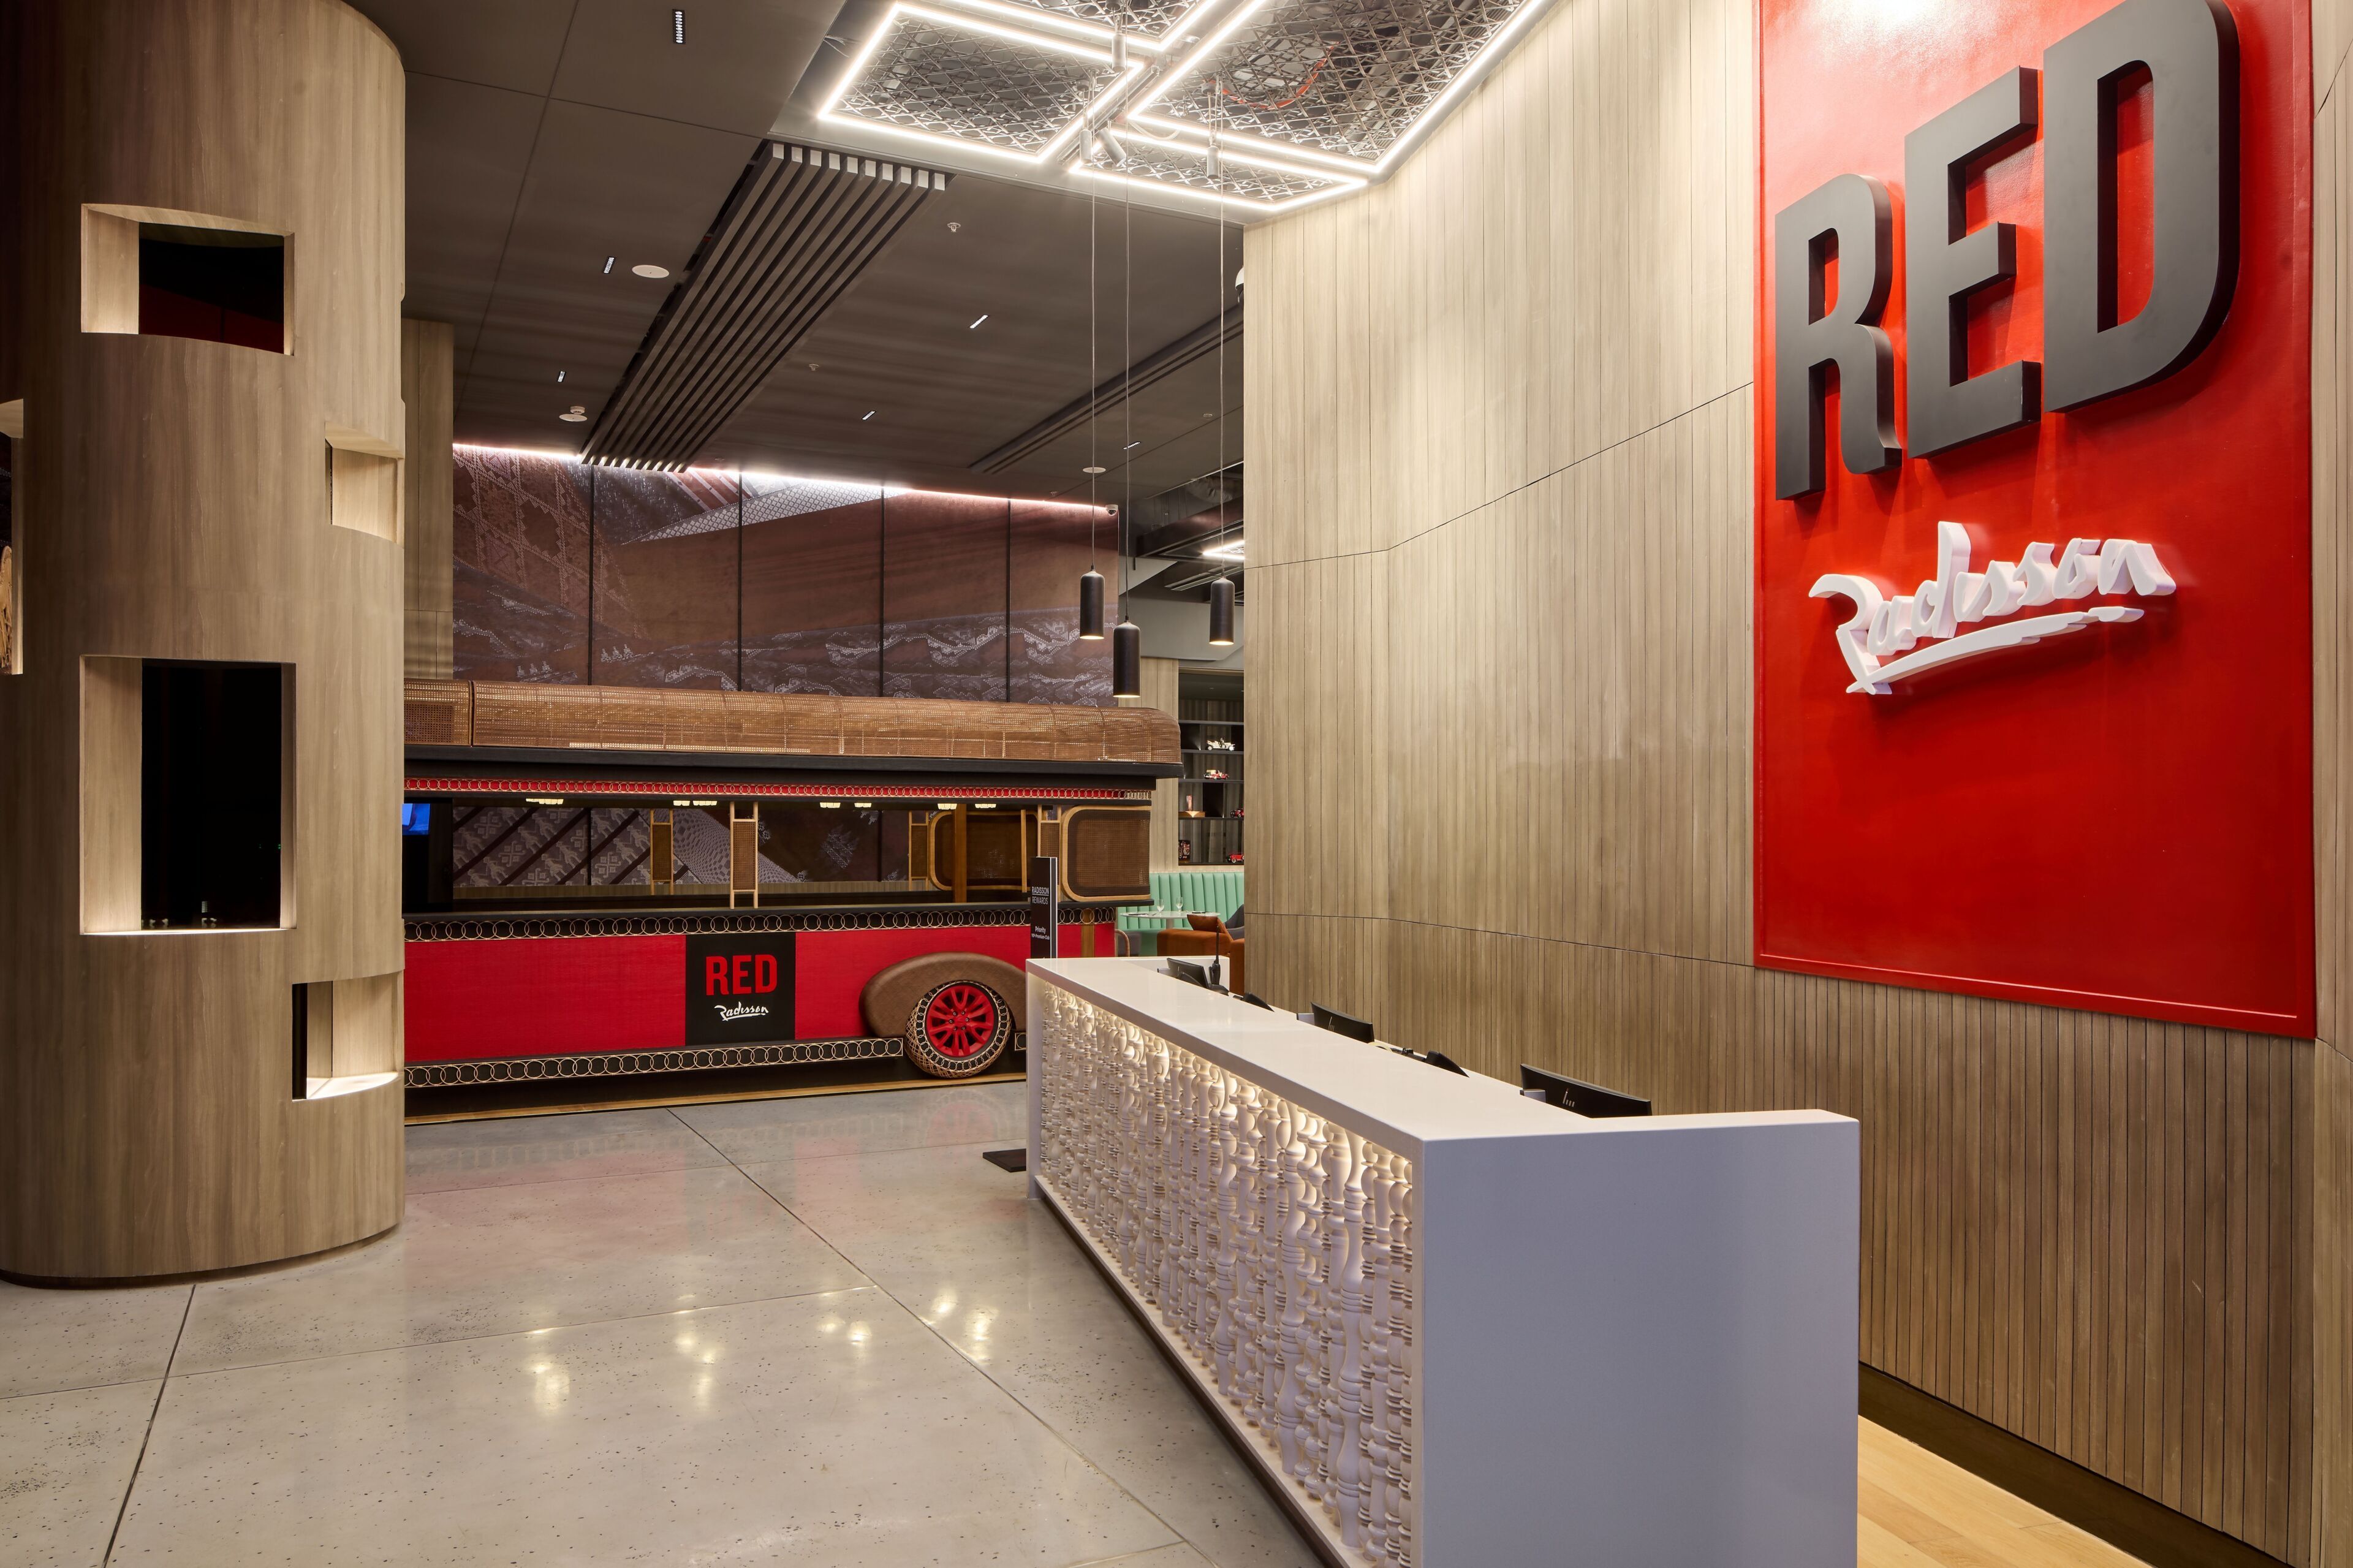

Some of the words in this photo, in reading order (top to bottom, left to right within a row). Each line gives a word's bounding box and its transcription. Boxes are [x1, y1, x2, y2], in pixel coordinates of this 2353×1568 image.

[1775, 0, 2240, 500] RED
[1809, 521, 2176, 694] Radisson
[706, 954, 778, 996] RED
[714, 1001, 769, 1021] Radisson
